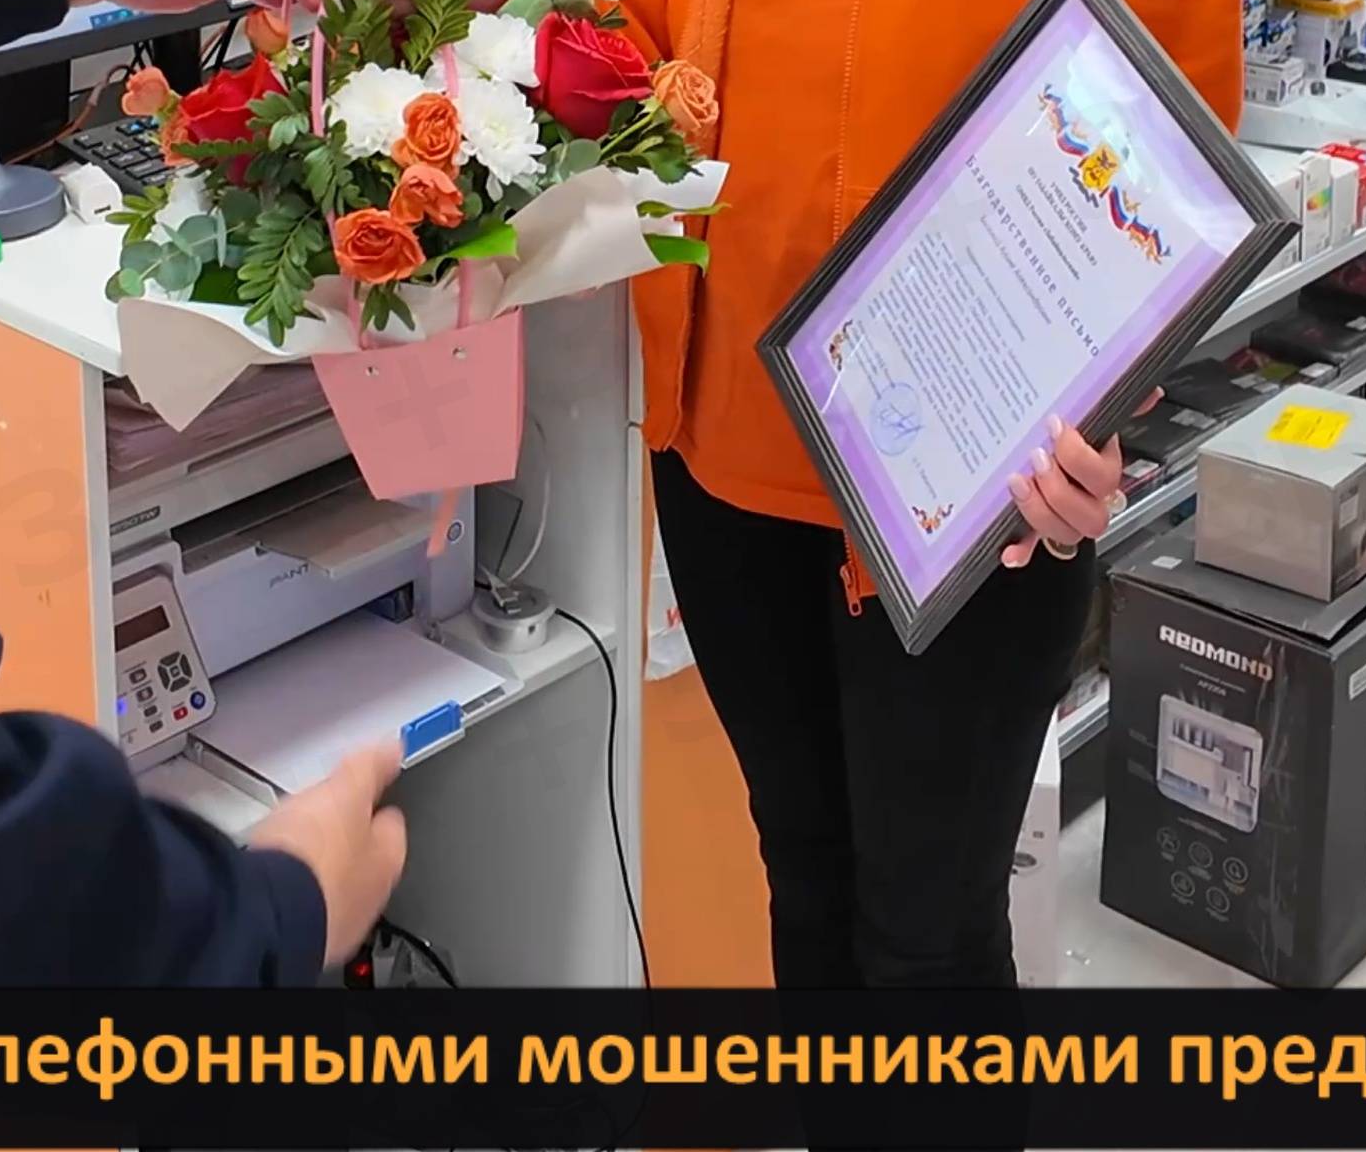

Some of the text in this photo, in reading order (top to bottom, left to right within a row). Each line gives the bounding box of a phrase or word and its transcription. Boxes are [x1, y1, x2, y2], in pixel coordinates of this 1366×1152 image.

[965, 154, 1057, 294] Благодарственное
[1056, 296, 1100, 358] письмо
[1159, 624, 1274, 682] REDMOND
